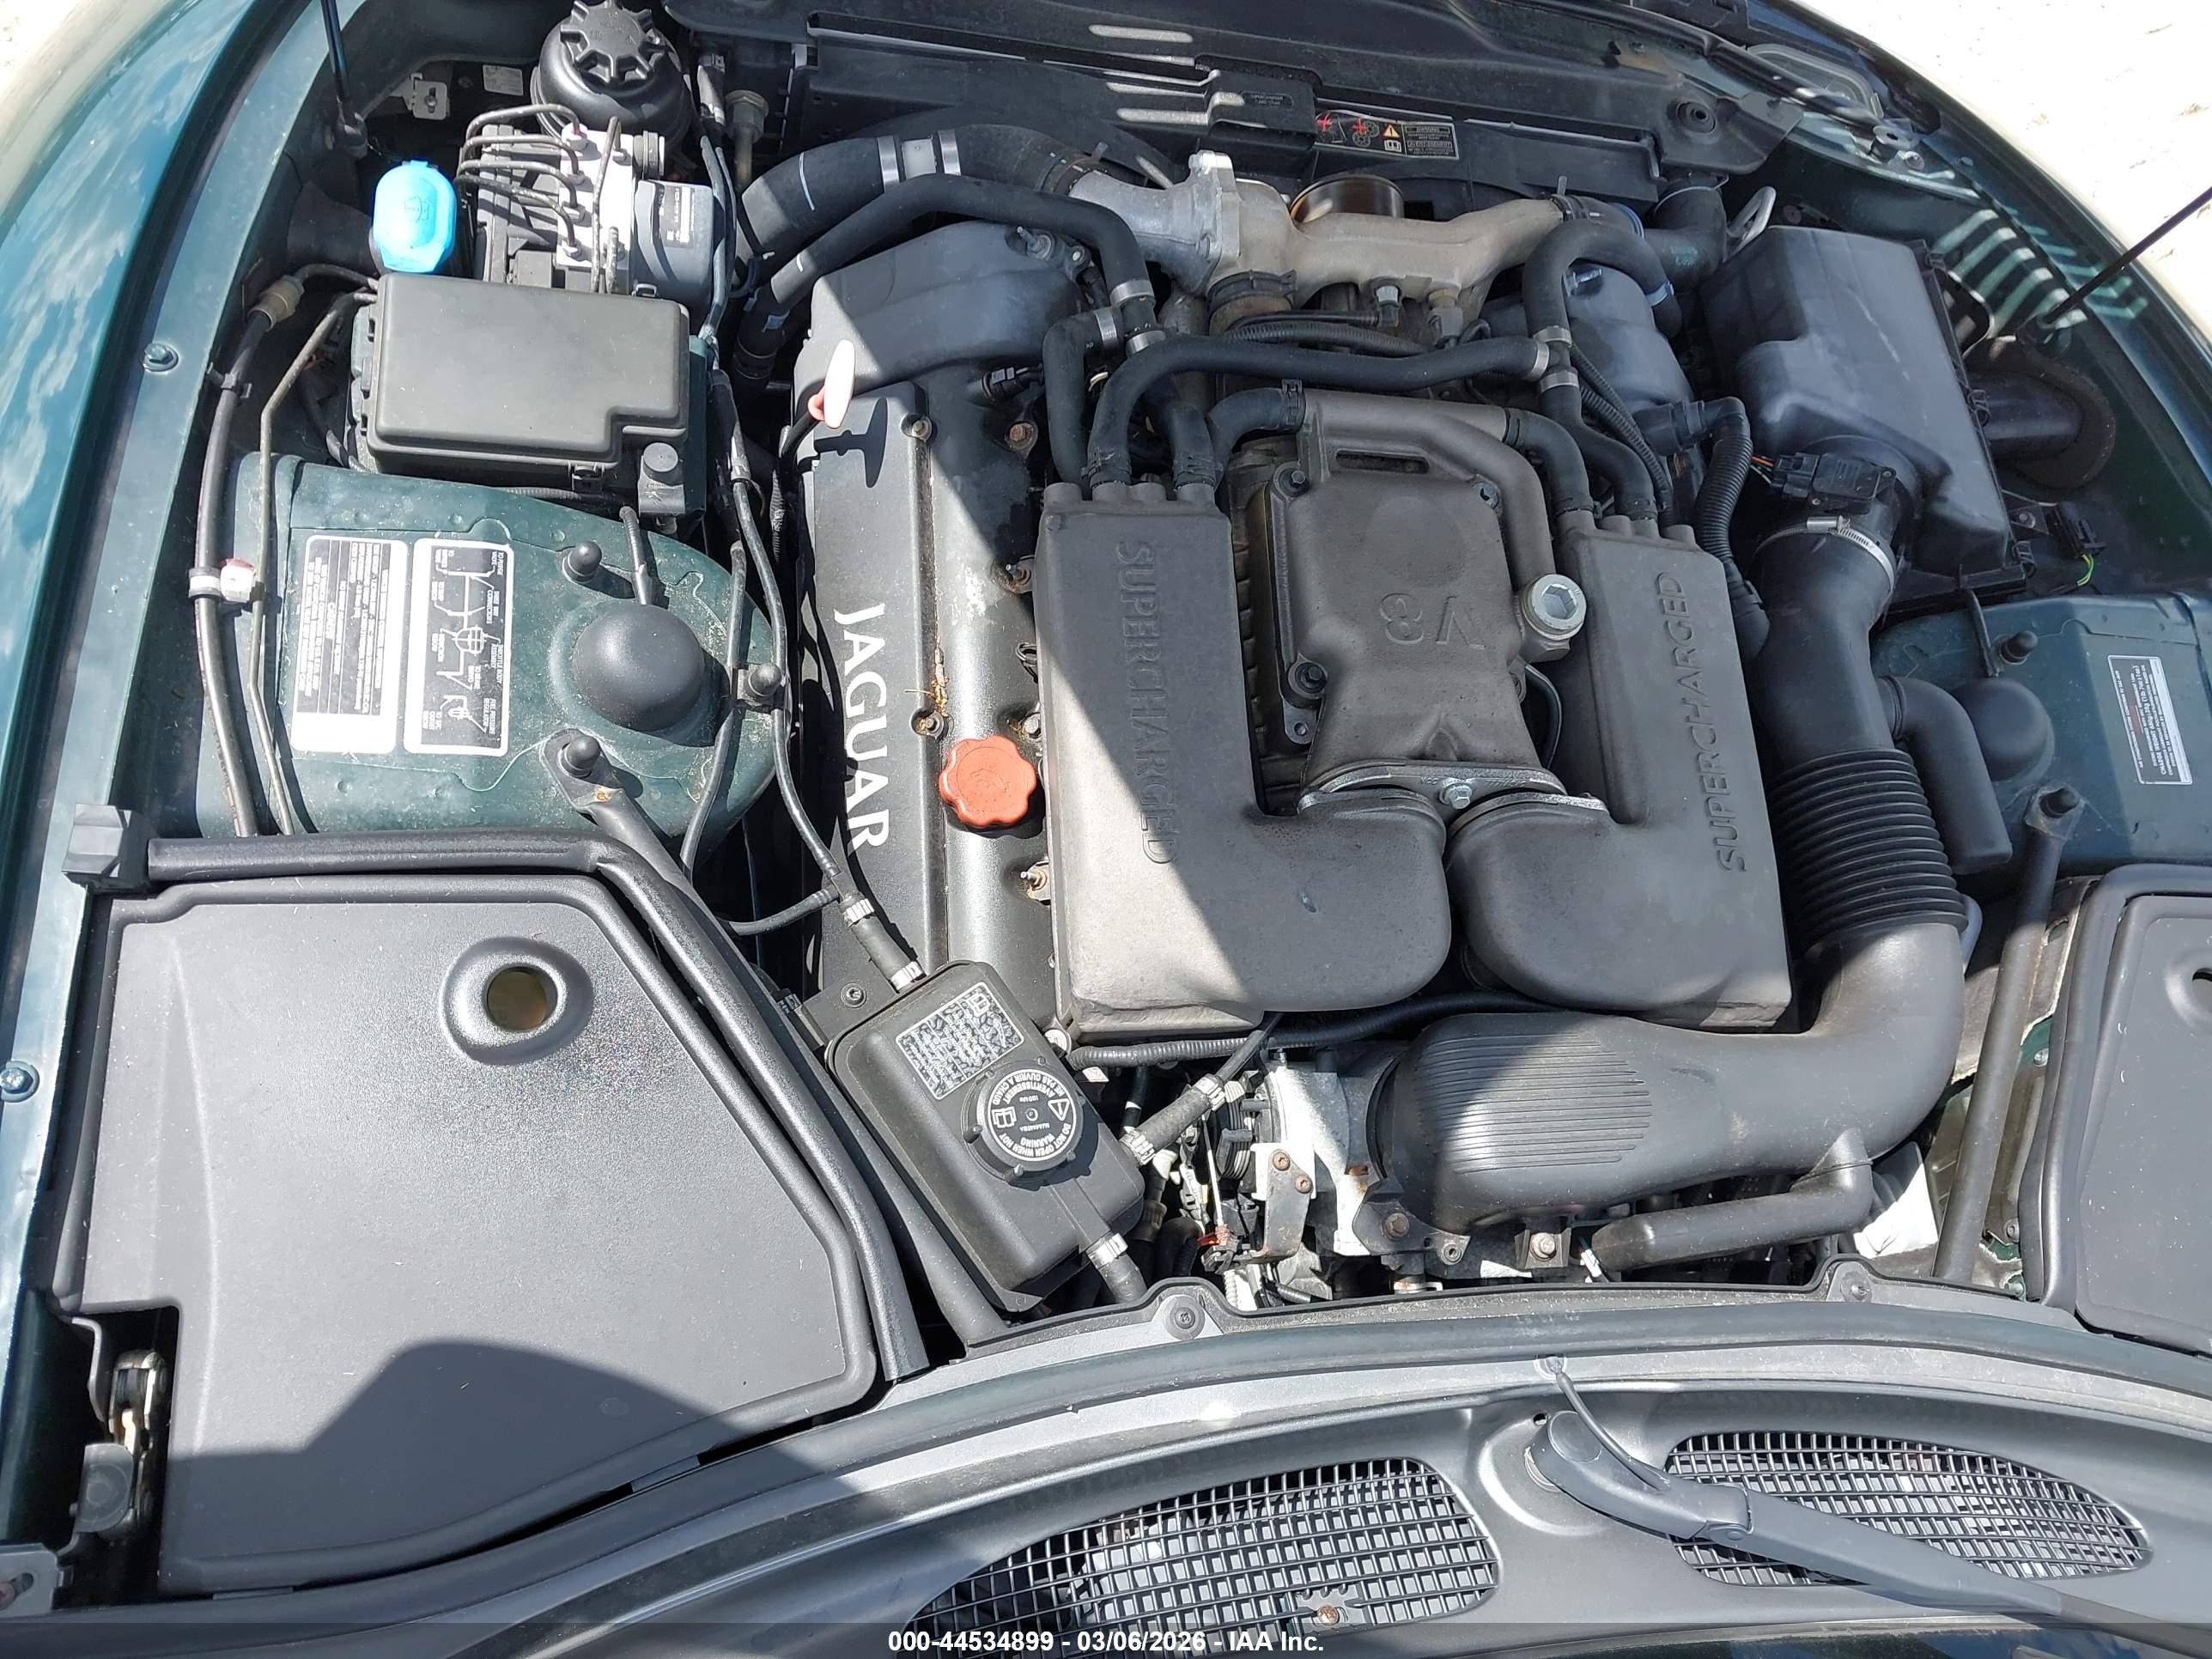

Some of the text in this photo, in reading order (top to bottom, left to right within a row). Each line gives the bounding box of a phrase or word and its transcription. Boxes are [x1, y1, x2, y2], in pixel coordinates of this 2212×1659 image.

[1379, 593, 1485, 650] V8
[1116, 541, 1180, 865] SUPERCHARGED
[834, 603, 890, 858] JAGUAR
[1656, 571, 1747, 872] SUPERCHARGED
[1014, 1072, 1041, 1082] OUVRIR
[1041, 1076, 1055, 1086] PAS
[992, 1082, 1009, 1104] CHAUD
[1003, 1081, 1054, 1103] AVERTISSEMENT
[1054, 1085, 1065, 1097] NE
[999, 1122, 1070, 1156] DO NOT OPEN WHEN HOT
[1020, 1133, 1054, 1146] WARNING
